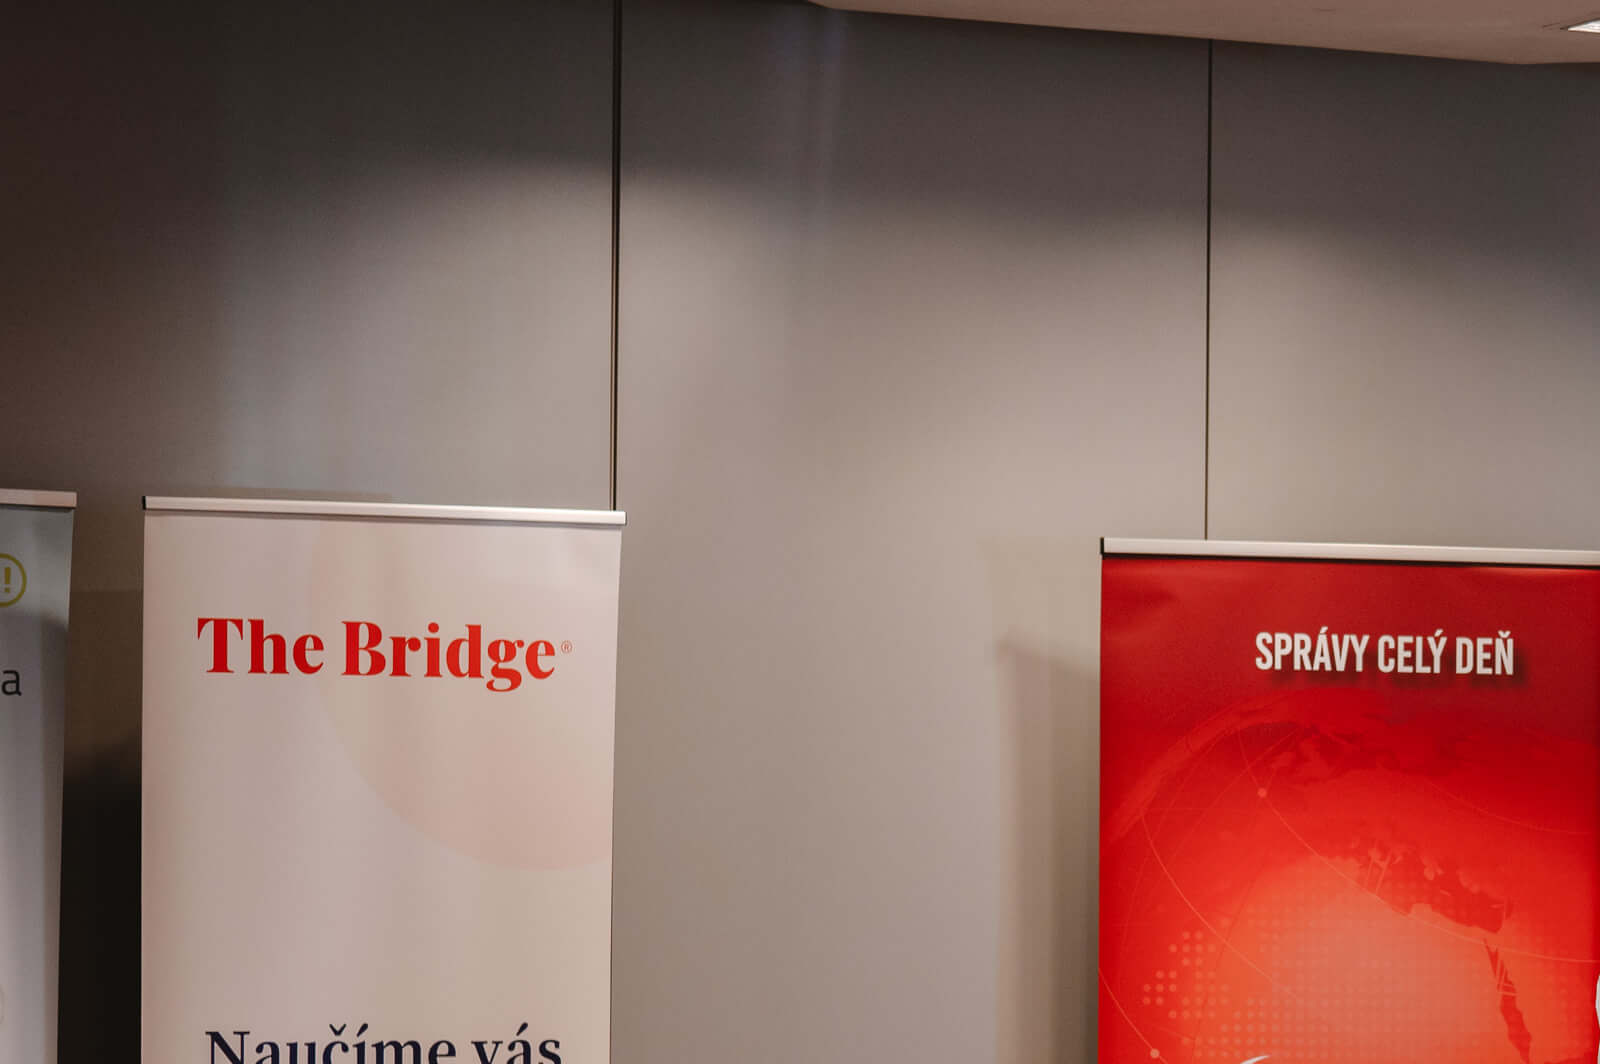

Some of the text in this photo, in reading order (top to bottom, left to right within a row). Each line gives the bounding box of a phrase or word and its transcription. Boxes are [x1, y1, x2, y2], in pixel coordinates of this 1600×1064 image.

[197, 617, 325, 675] The
[1255, 626, 1514, 676] SPRÁVY CELÝ DEŇ
